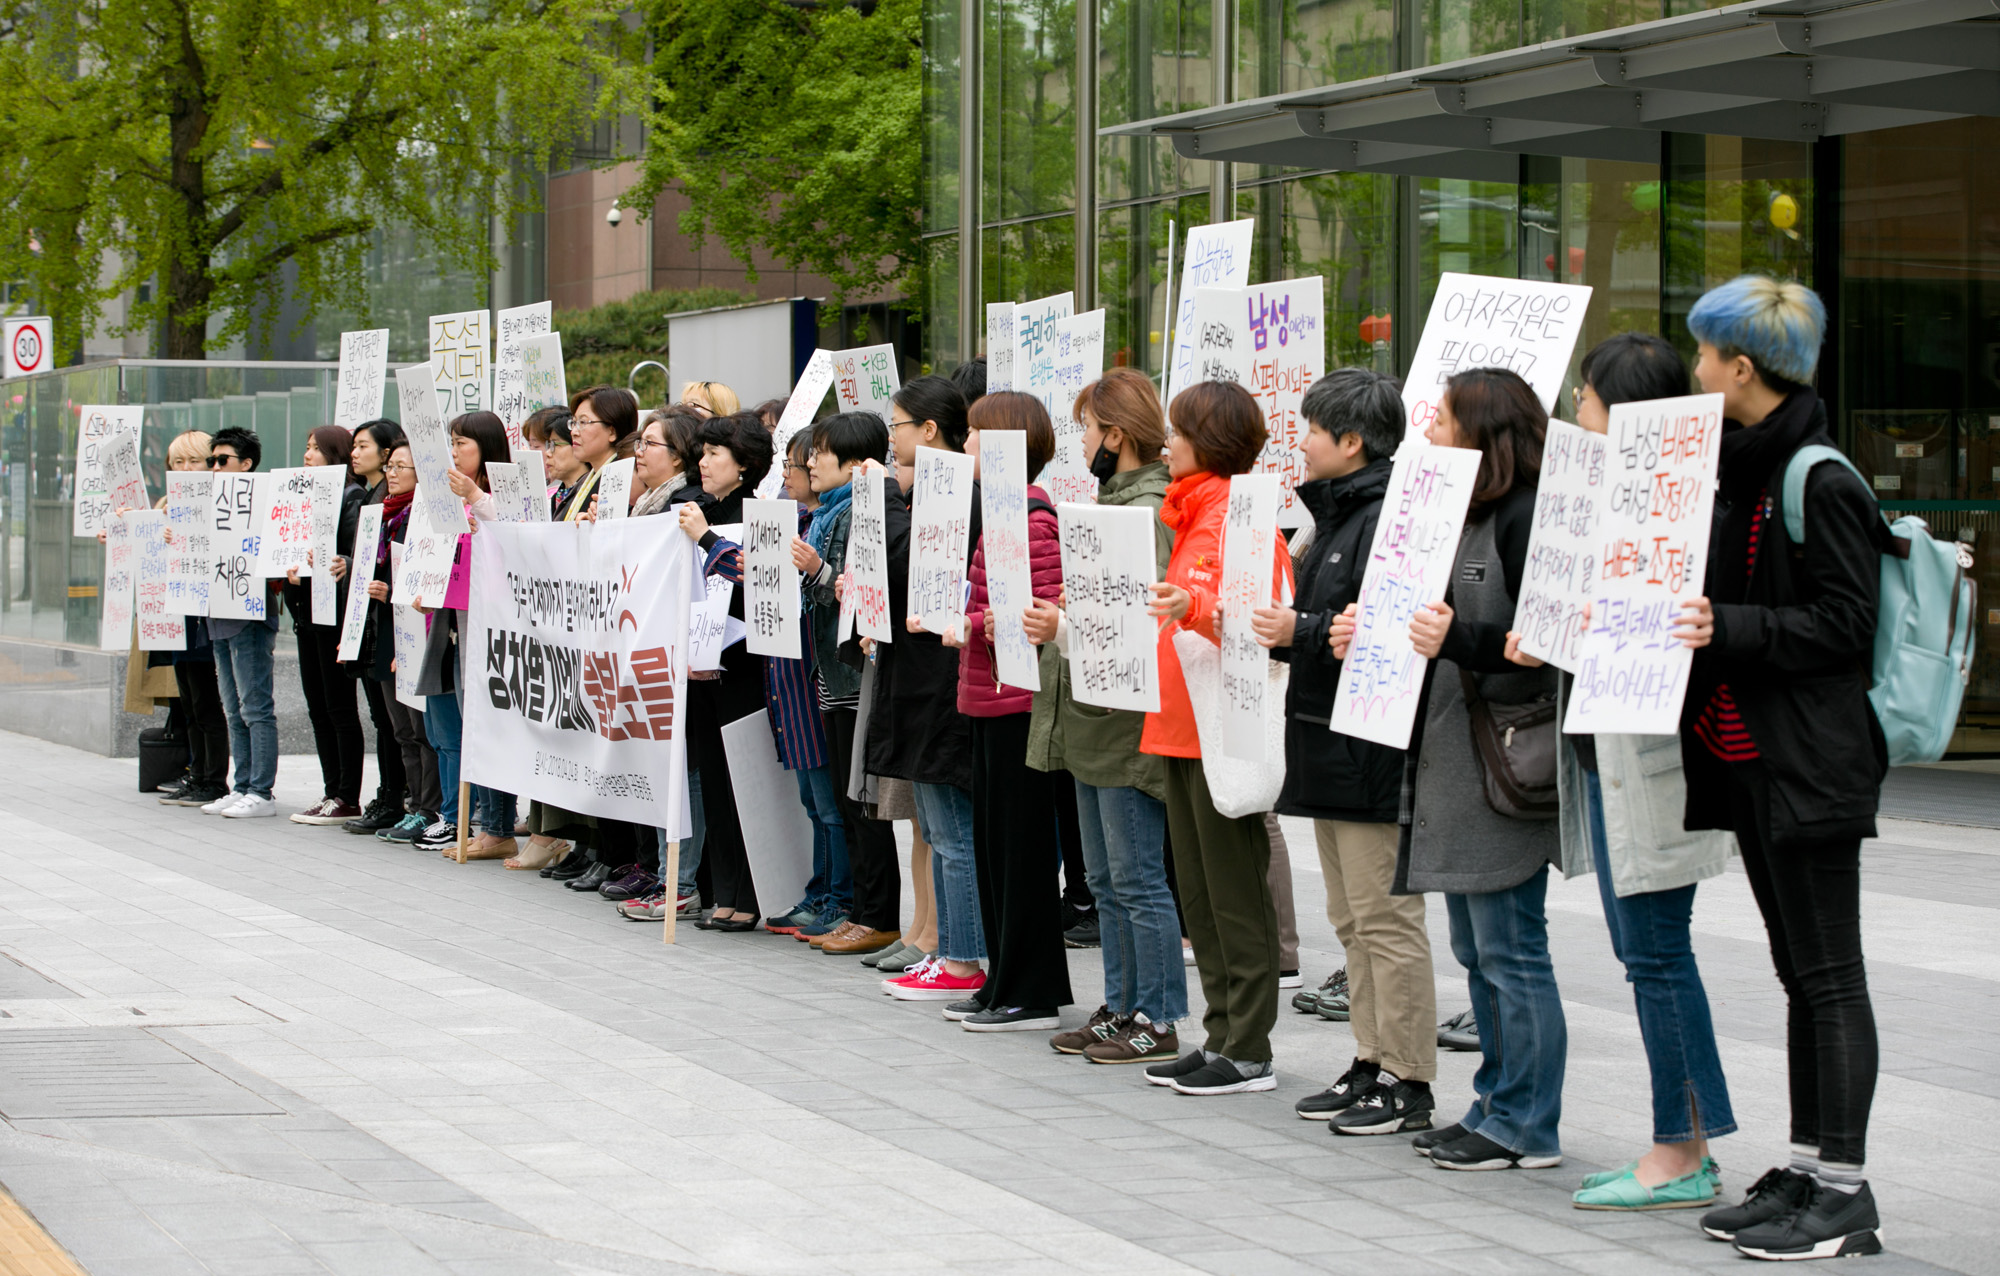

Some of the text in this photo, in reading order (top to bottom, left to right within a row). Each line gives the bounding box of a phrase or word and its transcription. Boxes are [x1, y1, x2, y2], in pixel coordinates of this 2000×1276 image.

[1445, 289, 1570, 342] 여자직원은
[19, 337, 36, 357] 30
[346, 330, 381, 363] 남자들만
[434, 313, 482, 353] 조선
[361, 362, 379, 391] 사는
[435, 350, 483, 383] 시대
[870, 352, 889, 372] KEB
[1055, 366, 1072, 387] 개인의
[435, 381, 481, 415] 기업
[841, 378, 860, 407] 국민
[870, 374, 893, 401] 하나
[339, 392, 360, 422] 그런
[215, 476, 255, 531] 실력
[271, 499, 299, 524] 여자는
[279, 521, 290, 543] 안
[291, 519, 313, 543] 뽑겠
[750, 518, 782, 555] 21세기다
[214, 555, 252, 601] 채용
[752, 564, 781, 598] 구시대의
[244, 594, 265, 618] 하라
[753, 600, 784, 639] 유물들아
